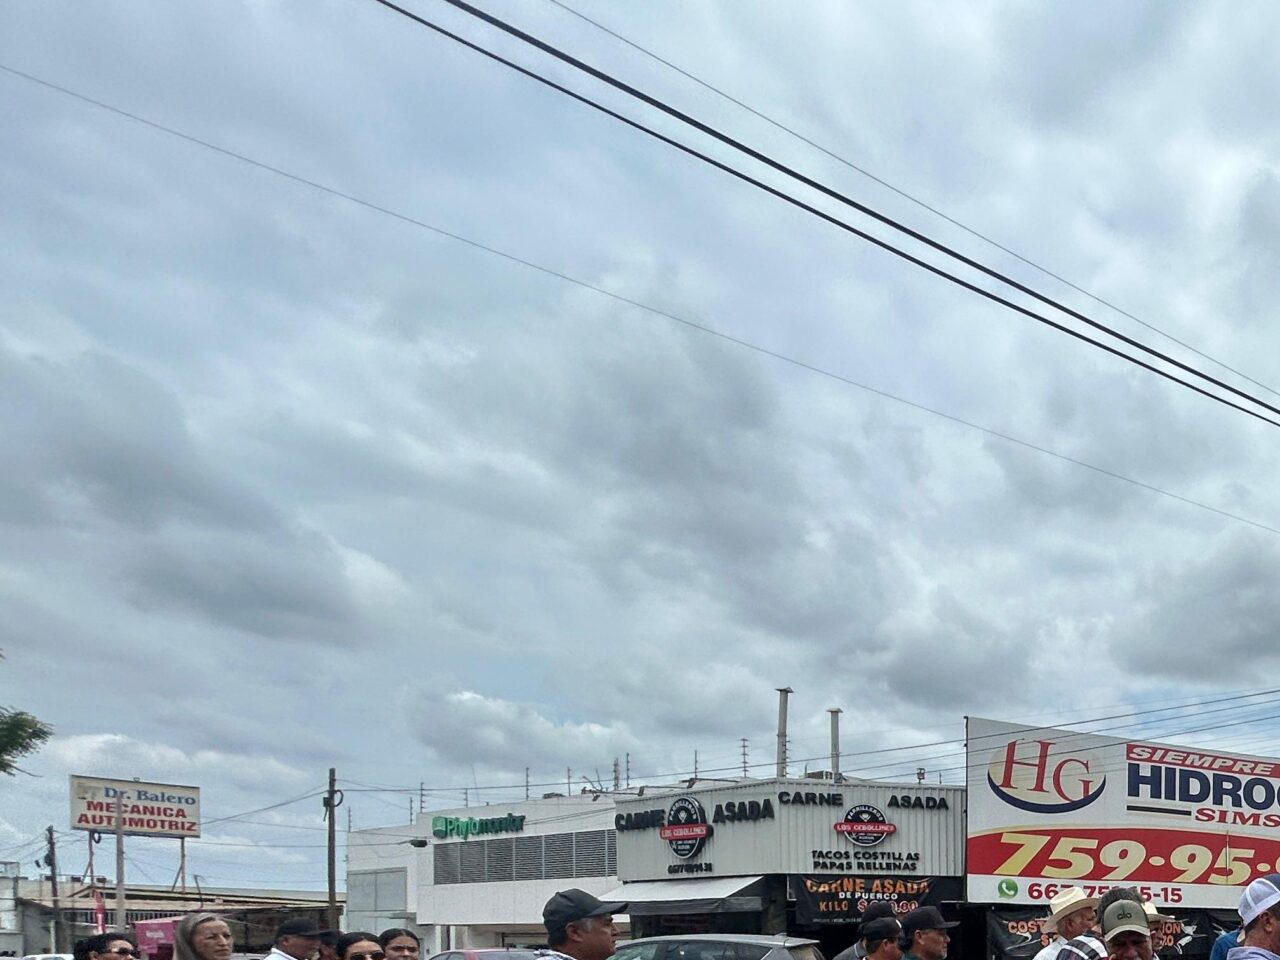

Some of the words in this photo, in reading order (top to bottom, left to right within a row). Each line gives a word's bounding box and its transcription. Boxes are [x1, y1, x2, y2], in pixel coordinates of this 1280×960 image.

[1129, 747, 1272, 775] SIEMPRE
[104, 787, 131, 800] Dr.
[136, 790, 197, 806] Balero
[778, 791, 844, 807] CARNE
[887, 794, 950, 811] ASADA
[712, 798, 775, 824] ASADA
[811, 850, 850, 860] TACOS
[857, 862, 917, 871] RELLENAS
[872, 878, 929, 894] ASADA
[854, 892, 898, 900] PUERCO
[820, 901, 849, 911] KILO
